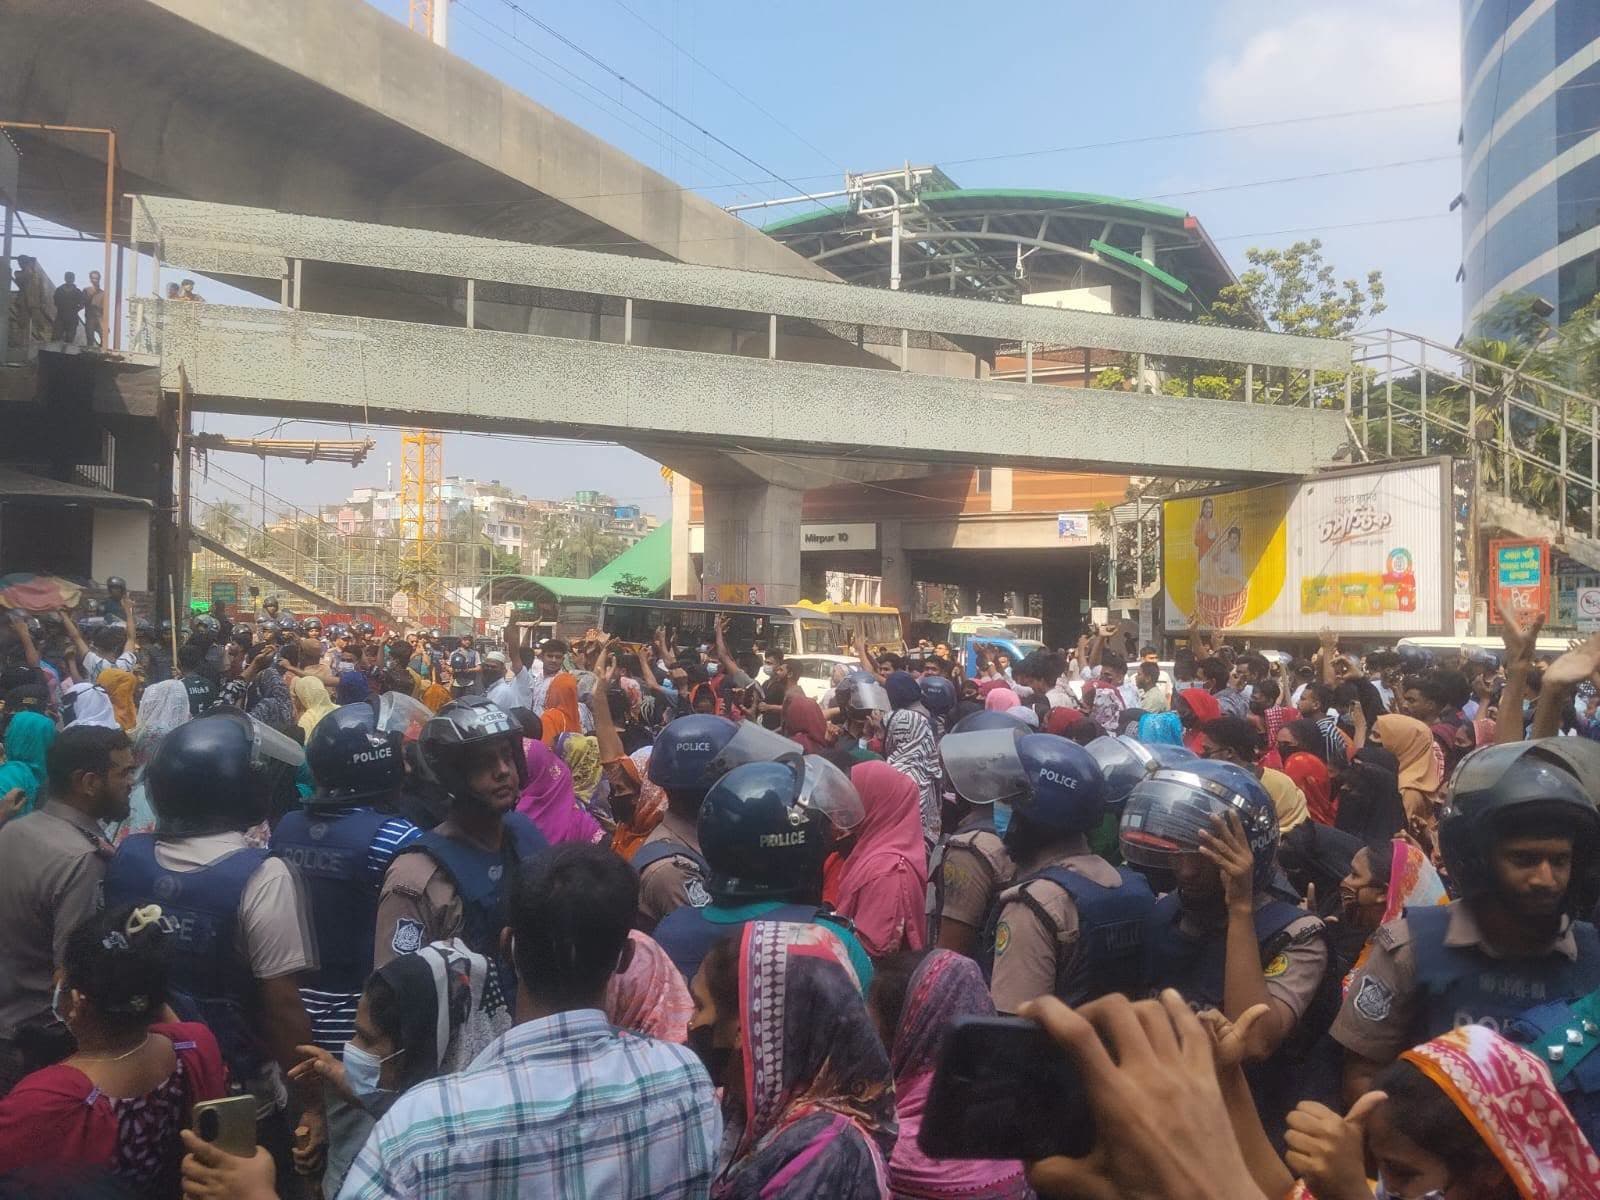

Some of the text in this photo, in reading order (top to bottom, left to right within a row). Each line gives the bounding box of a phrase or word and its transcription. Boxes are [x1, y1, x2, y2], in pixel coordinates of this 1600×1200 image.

[804, 532, 849, 543] Mirpur 10
[676, 742, 711, 751] POLICE
[352, 747, 392, 764] POLICE
[1039, 768, 1078, 790] POLICE
[284, 847, 344, 873] POLICE
